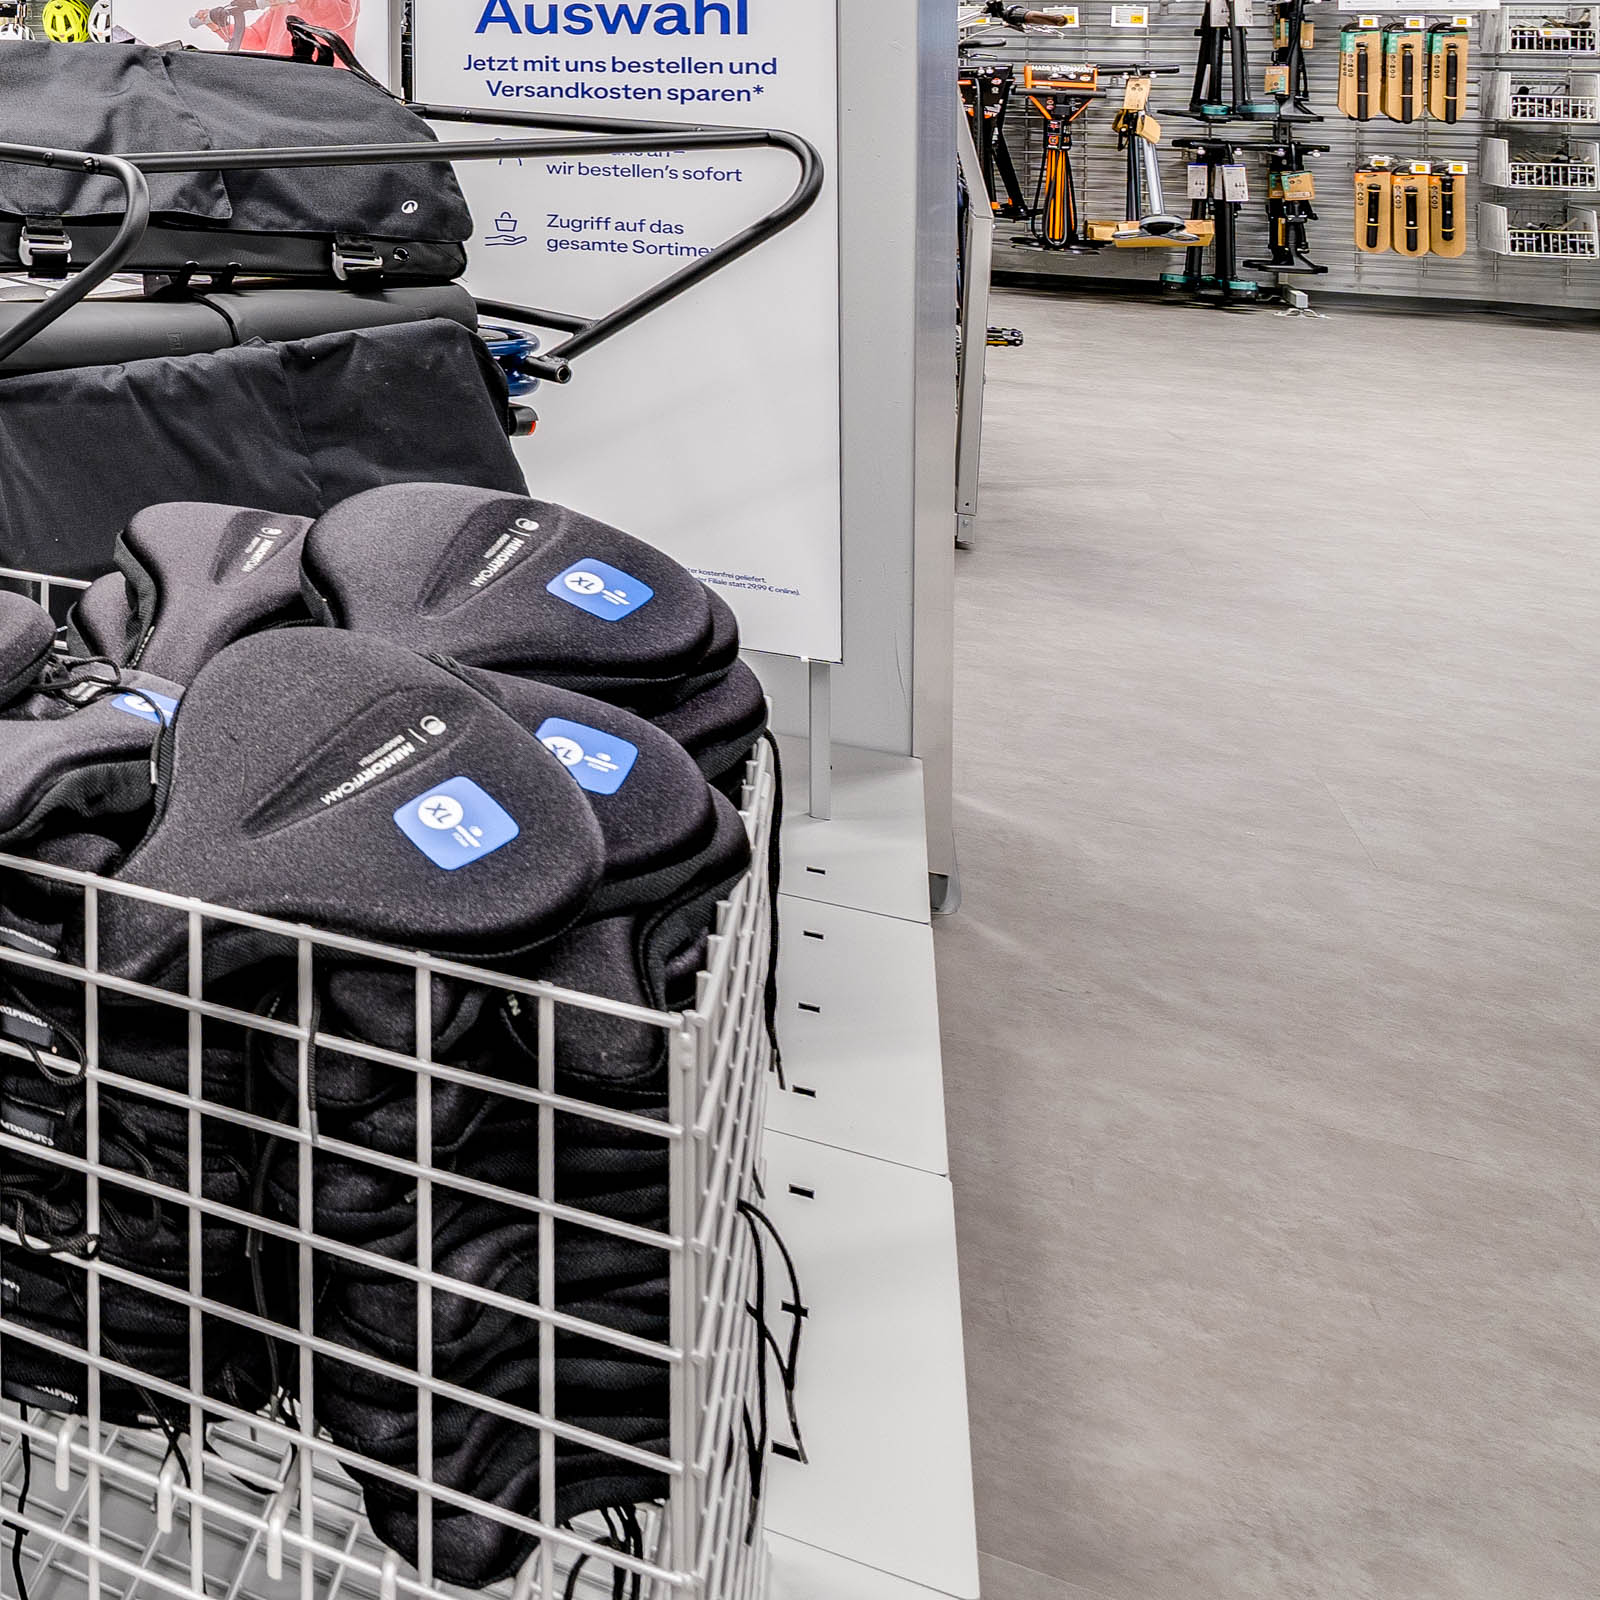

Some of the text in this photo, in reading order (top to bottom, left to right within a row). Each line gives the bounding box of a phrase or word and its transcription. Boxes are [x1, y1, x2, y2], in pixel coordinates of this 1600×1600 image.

[463, 54, 777, 76] Jetzt mit uns bestellen und
[486, 80, 663, 101] Versandkosten
[546, 161, 574, 179] wir
[682, 164, 742, 183] sofort
[546, 214, 684, 235] Zugriff auf das
[546, 236, 628, 256] gesamte
[698, 568, 734, 579] kostenfrei
[735, 573, 767, 583] geliefert.
[708, 577, 728, 586] Filiale
[728, 581, 746, 589] statt
[747, 582, 767, 591] 29,99
[319, 741, 416, 806] MEMORYFOAM
